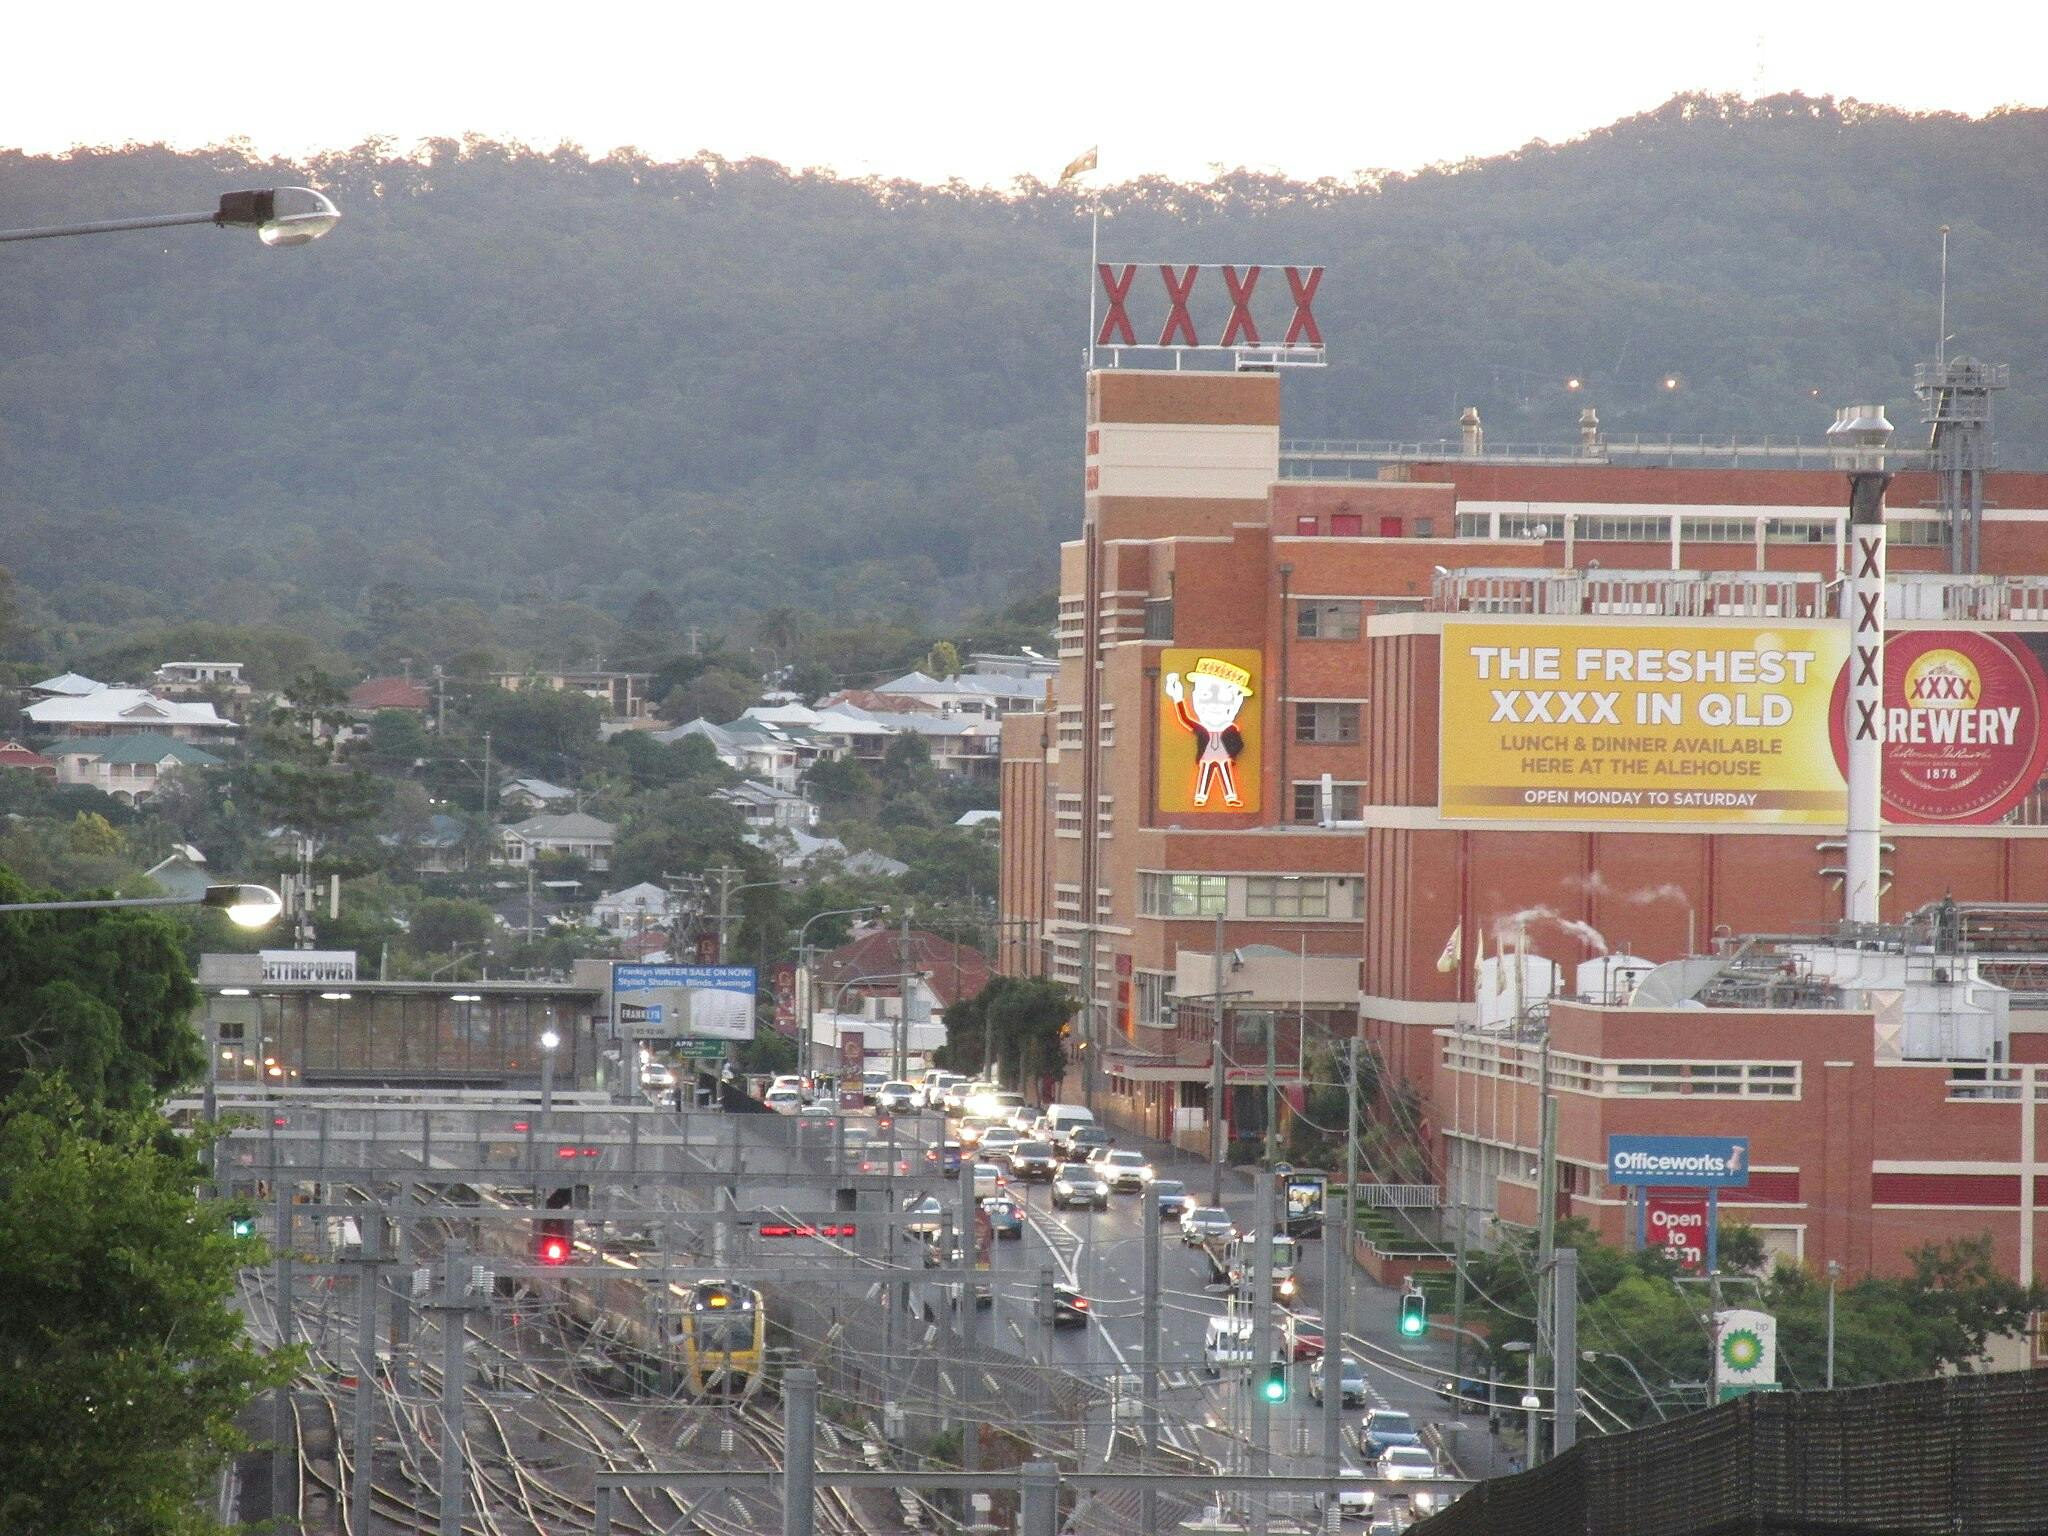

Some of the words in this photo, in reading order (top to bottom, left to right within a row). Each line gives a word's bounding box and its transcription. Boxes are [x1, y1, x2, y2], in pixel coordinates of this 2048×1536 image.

[1097, 264, 1325, 348] XXXX
[1470, 647, 1562, 680] THE
[1575, 649, 1816, 684] FRESHEST
[1910, 676, 1975, 700] XXXX
[1490, 690, 1623, 725] XXXX
[1635, 691, 1682, 726] IN
[1698, 693, 1794, 728] QLD
[1501, 735, 1571, 752] LUNCH
[1574, 736, 1587, 753] &
[1592, 737, 1666, 754] DINNER
[1672, 738, 1783, 755] AVAILABLE
[1521, 757, 1575, 774] HERE
[1579, 758, 1604, 775] AT
[1610, 759, 1649, 775] THE
[1654, 759, 1761, 777] ALEHOUSE
[1926, 768, 1957, 780] 1878
[1524, 790, 1570, 805] OPEN
[1574, 791, 1642, 806] MONDAY
[1648, 791, 1669, 806] TO
[1674, 792, 1758, 807] SATURDAY
[655, 968, 688, 976] WINTER
[690, 968, 711, 976] SALE
[1614, 1151, 1724, 1171] Officeworks
[1652, 1210, 1701, 1229] Open
[1668, 1229, 1687, 1245] to
[1756, 1321, 1768, 1333] bp
